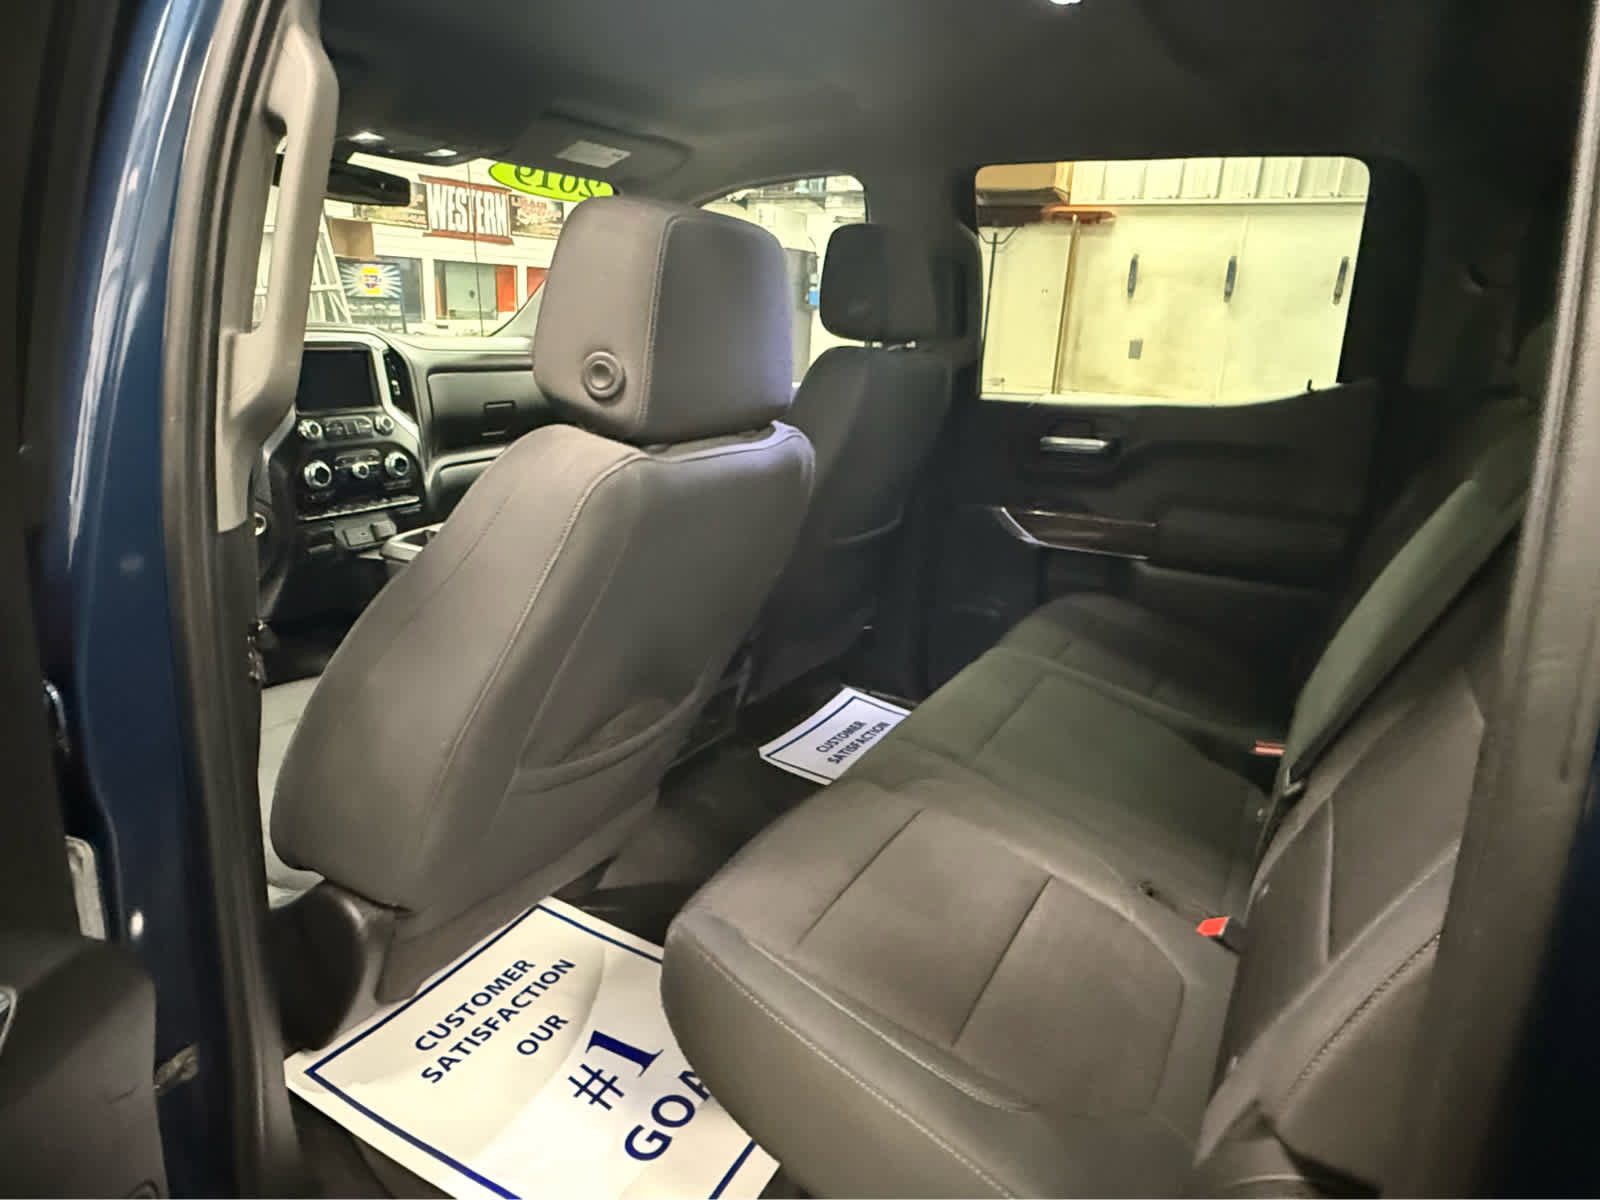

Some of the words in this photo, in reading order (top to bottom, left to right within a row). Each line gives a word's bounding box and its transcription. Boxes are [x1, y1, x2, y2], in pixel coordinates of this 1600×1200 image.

[427, 183, 508, 237] WESTERN
[815, 720, 867, 753] CUSTOMER
[827, 722, 890, 764] SATISFACTION
[416, 960, 535, 1050] CUSTOMER
[422, 960, 576, 1083] SATISFACTION
[517, 1015, 569, 1056] OUR
[569, 1030, 664, 1110] #1
[625, 1071, 711, 1161] GOA
